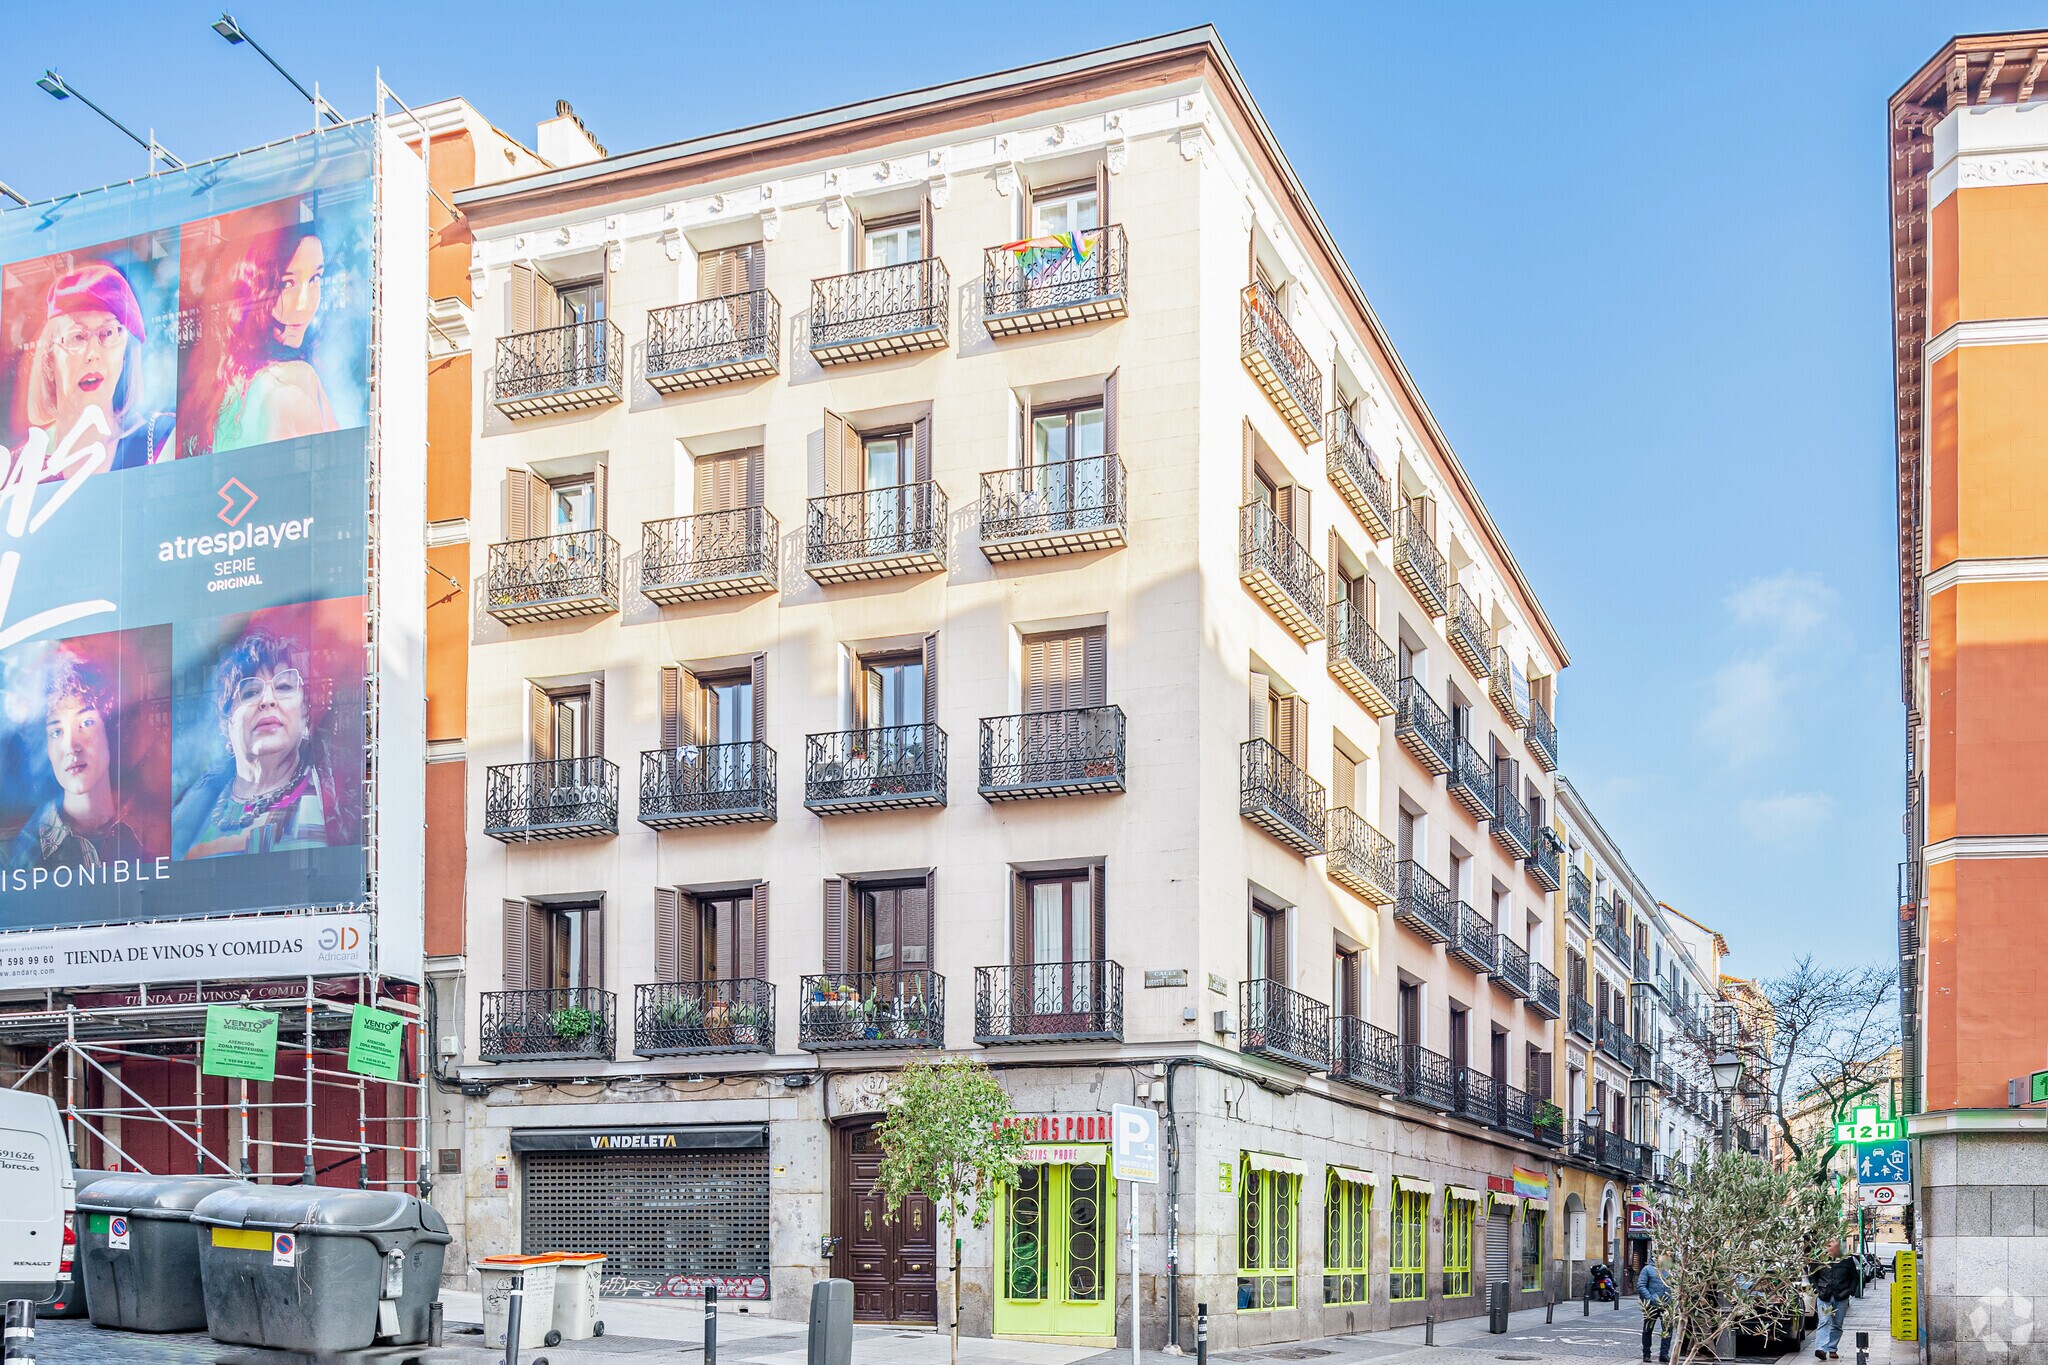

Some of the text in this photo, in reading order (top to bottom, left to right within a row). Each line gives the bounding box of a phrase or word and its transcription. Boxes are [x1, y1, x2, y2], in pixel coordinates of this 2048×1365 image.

[158, 517, 314, 562] atresplayer
[214, 557, 256, 576] SERIE
[207, 574, 263, 592] ORIGINAL
[64, 939, 303, 965] TIENDA DE VINOS Y COMIDAS
[318, 952, 359, 962] Adricaral
[8, 957, 24, 966] 598
[28, 956, 39, 965] 99
[44, 955, 54, 964] 60
[179, 992, 197, 1002] DE
[201, 990, 240, 1001] VINOS
[245, 988, 255, 998] Y
[259, 984, 322, 997] COMIDS
[223, 1024, 262, 1033] SEGURIDAD
[224, 1018, 262, 1030] VENTO
[364, 1018, 392, 1031] VENTO
[364, 1024, 391, 1035] SEGURIDAD
[233, 1045, 264, 1053] PROTEGIDA
[870, 1076, 885, 1090] 37
[1119, 1112, 1150, 1155] P
[590, 1134, 677, 1148] VANDELETA
[1054, 1149, 1078, 1160] PADRE
